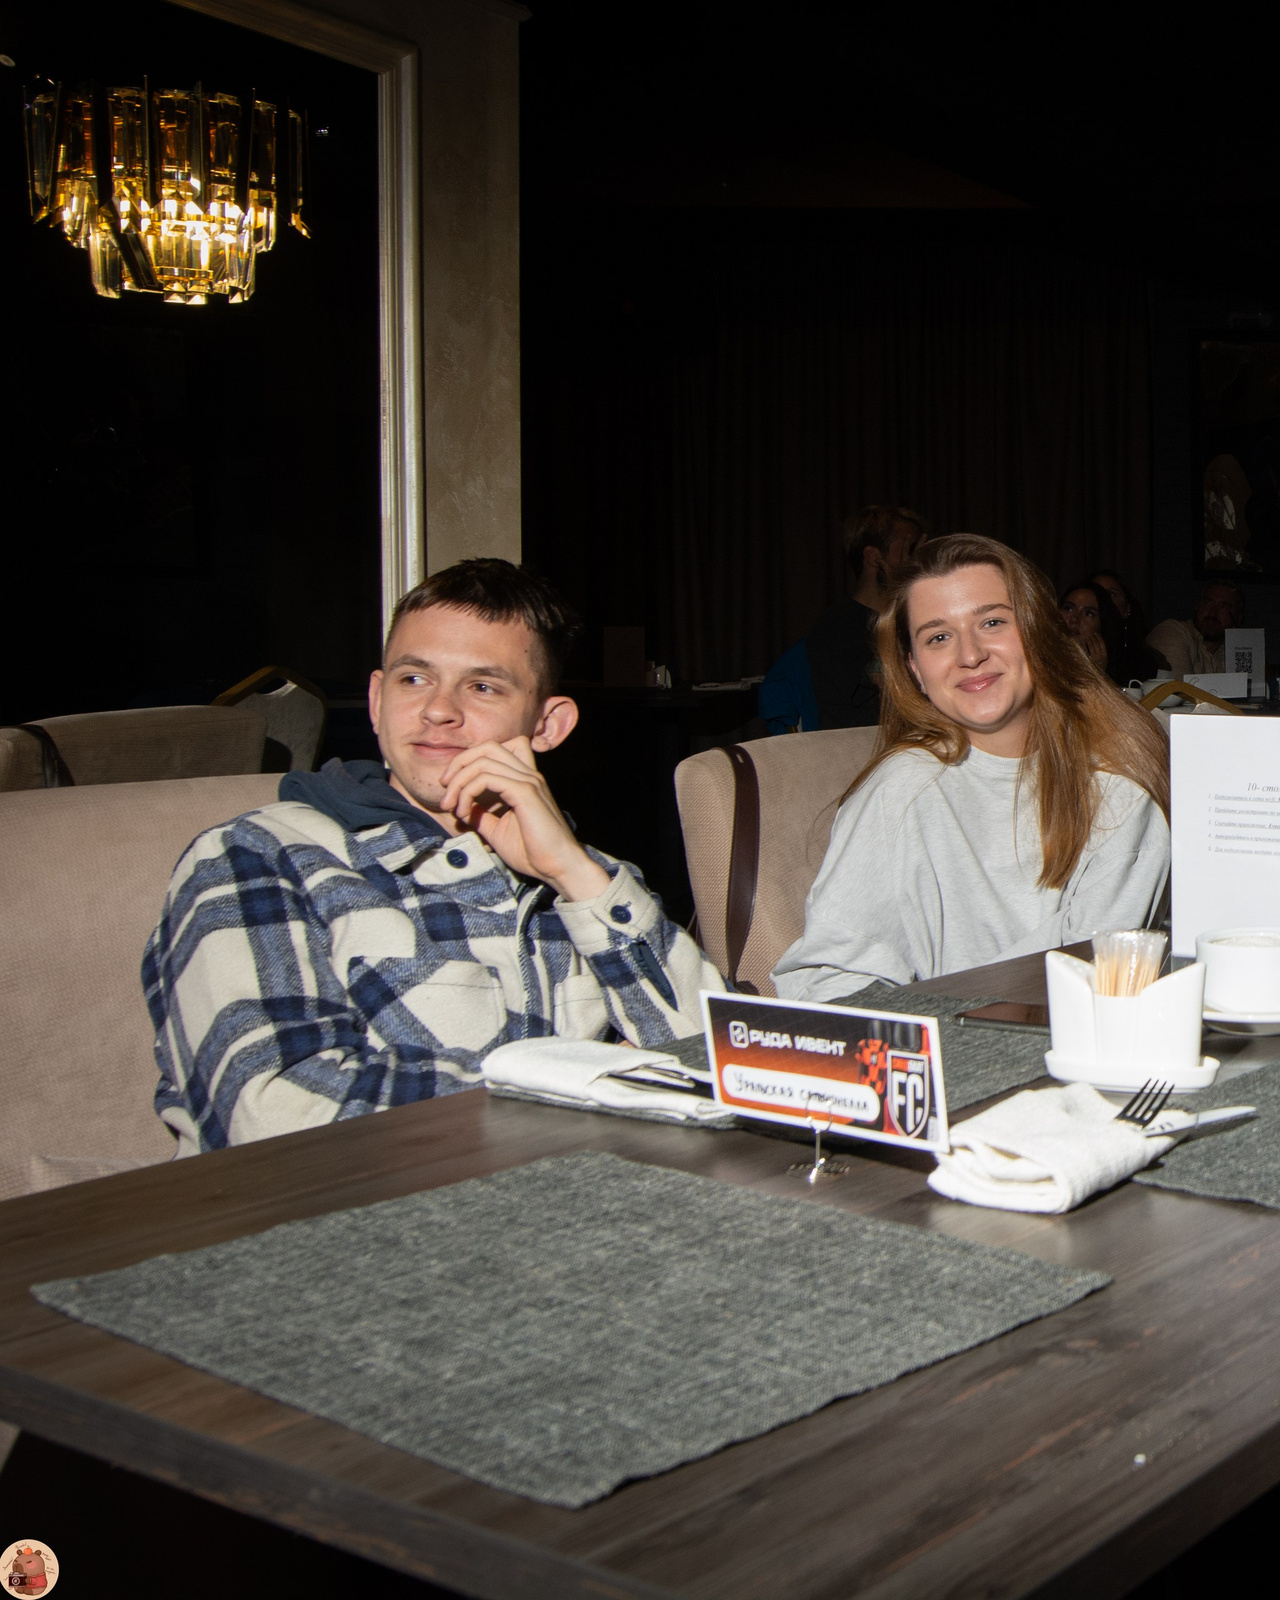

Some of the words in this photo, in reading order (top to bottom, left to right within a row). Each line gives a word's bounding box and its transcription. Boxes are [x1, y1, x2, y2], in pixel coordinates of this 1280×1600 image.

[748, 1029, 793, 1049] РУДА
[794, 1035, 847, 1057] ИВЕНТ
[892, 1070, 924, 1134] FC
